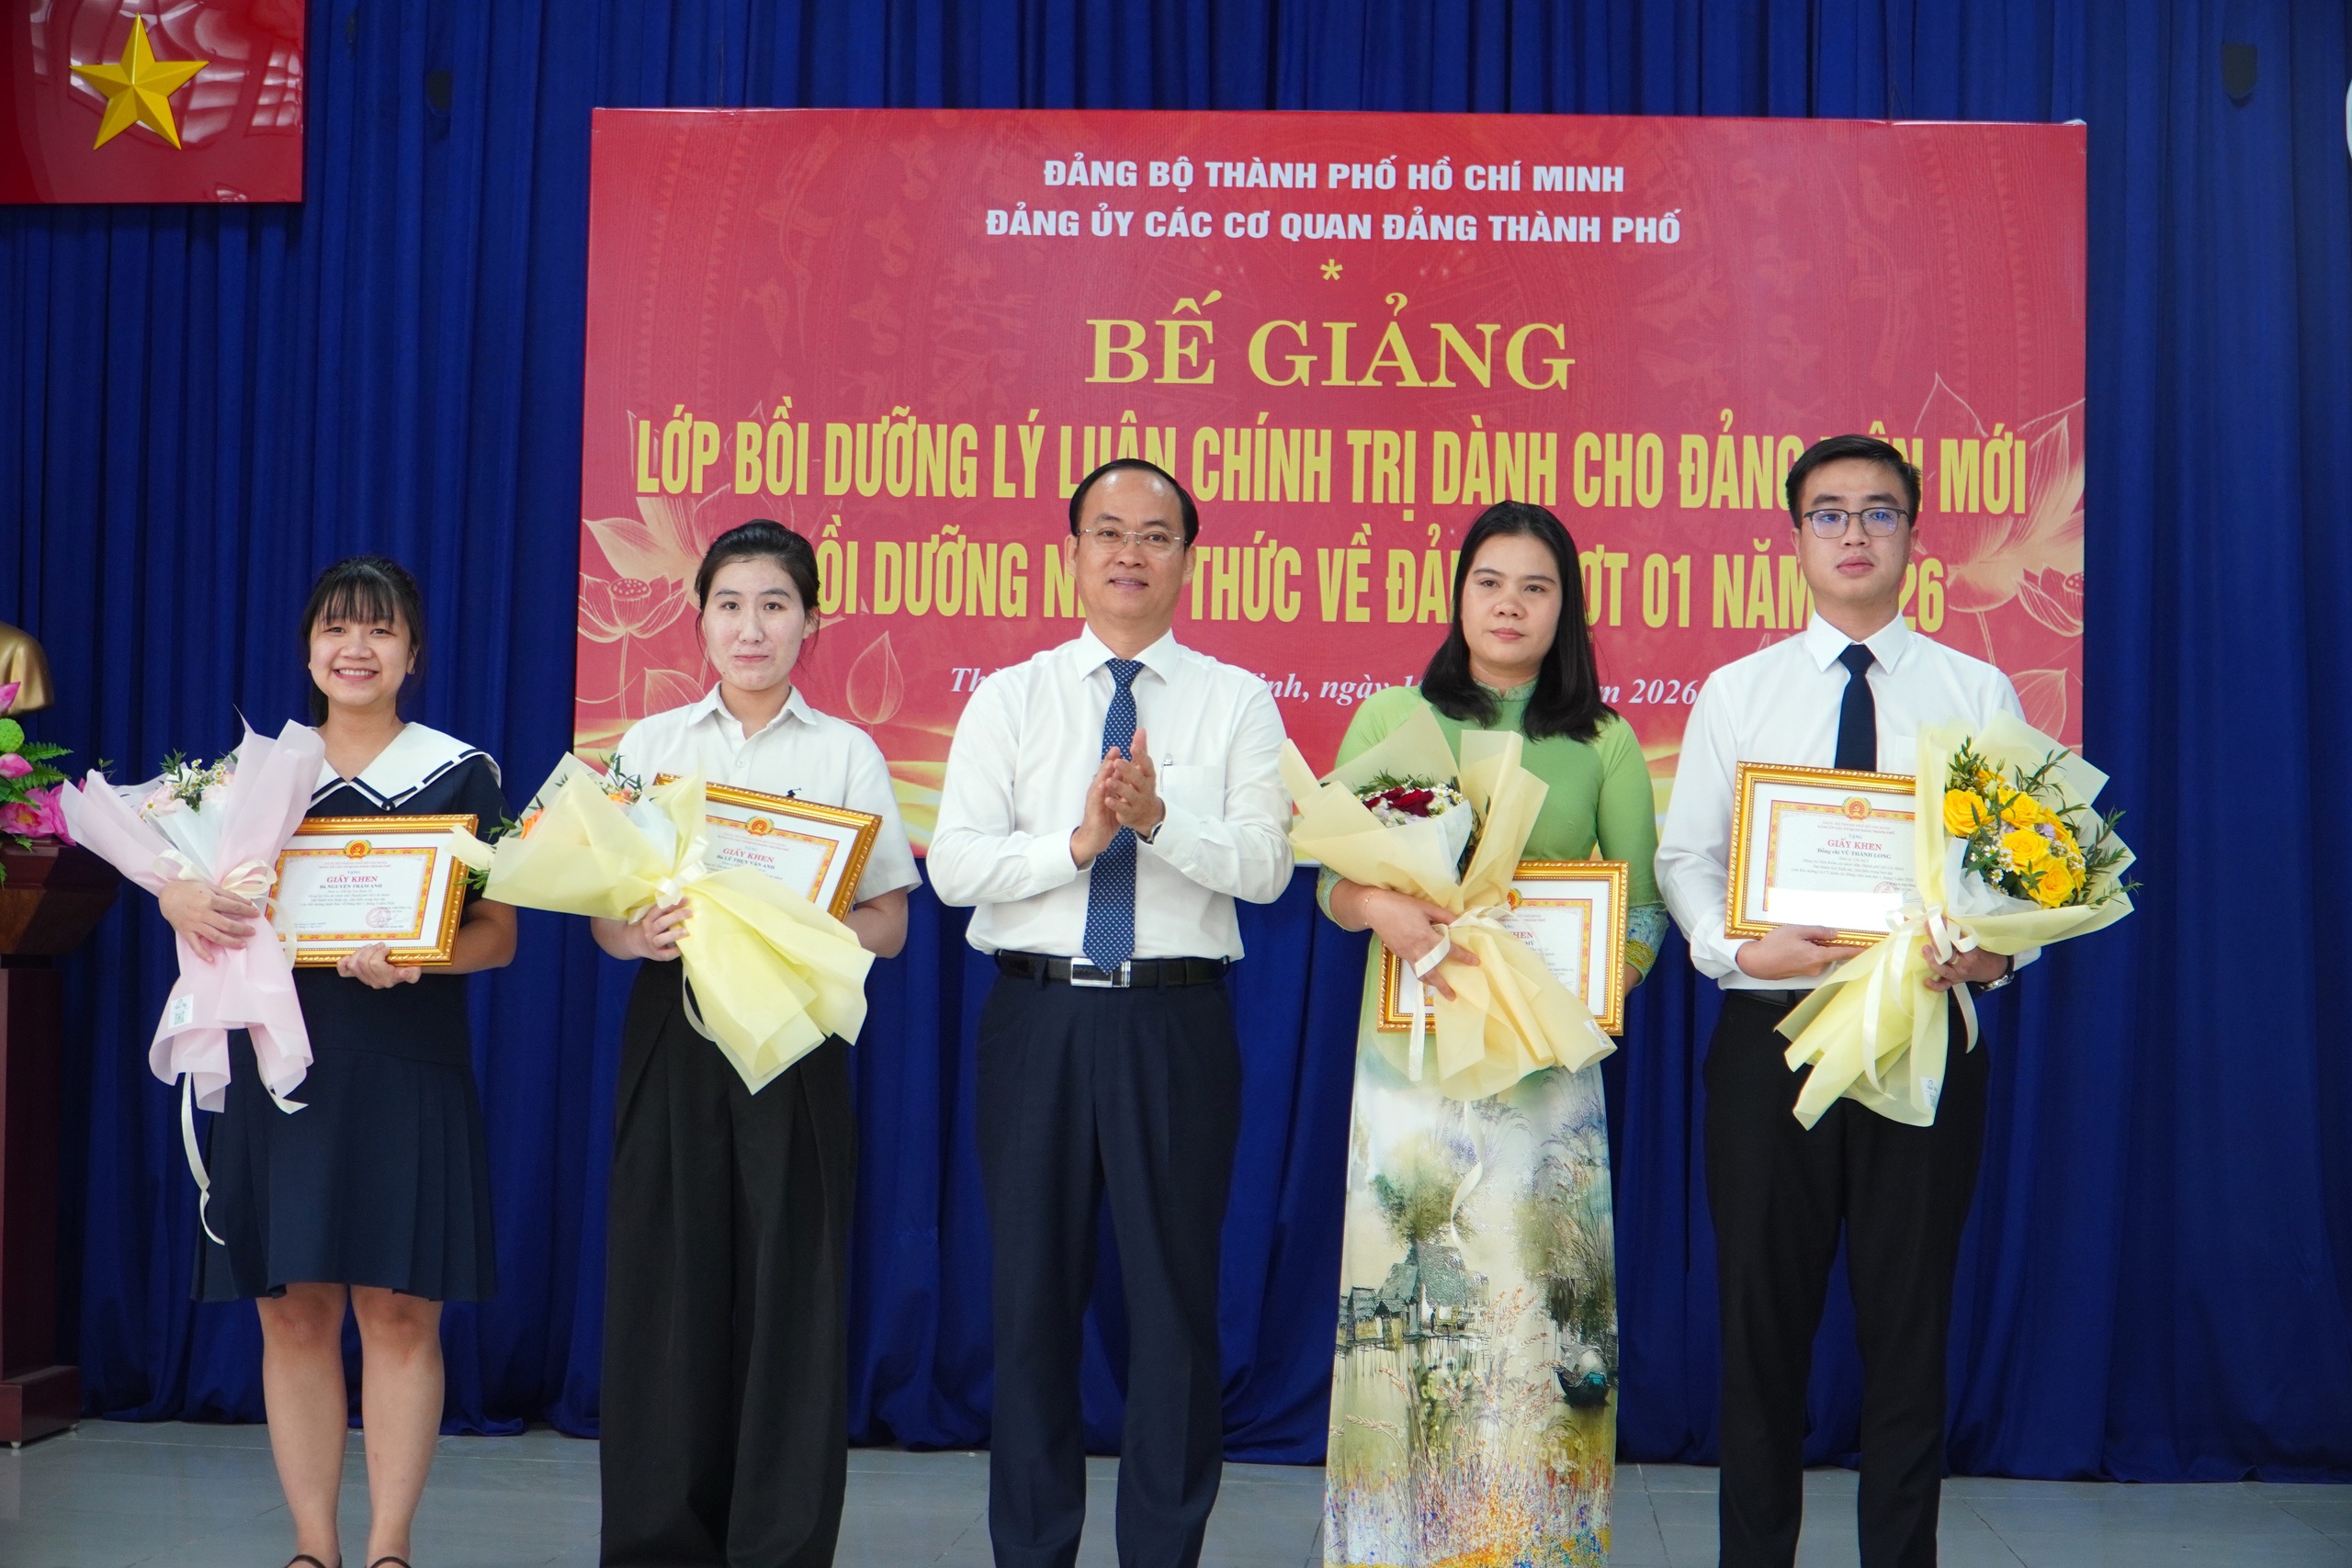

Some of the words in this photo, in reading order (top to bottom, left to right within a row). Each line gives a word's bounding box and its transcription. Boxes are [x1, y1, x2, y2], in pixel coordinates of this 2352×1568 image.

[1044, 152, 1137, 186] ĐẢNG
[1149, 155, 1193, 193] BỘ
[1204, 156, 1317, 189] THÀNH
[1329, 154, 1397, 190] PHỐ
[1408, 156, 1453, 190] HỒ
[1465, 160, 1521, 191] CHÍ
[1533, 166, 1624, 192] MINH
[986, 201, 1080, 236] ĐẢNG
[1091, 202, 1135, 237] ỦY
[1146, 206, 1213, 238] CÁC
[1225, 210, 1271, 239] CƠ
[1281, 213, 1372, 242] QUAN
[1382, 206, 1477, 241] ĐẢNG
[1488, 210, 1600, 243] THÀNH
[1612, 209, 1681, 244] PHỐ
[1085, 289, 1223, 385] BẾ
[1249, 292, 1576, 390] GIẢNG
[638, 404, 720, 494] LỚP
[735, 396, 808, 496] BỒI
[824, 406, 978, 498] DƯỠNG
[993, 408, 1046, 499] LÝ
[1193, 412, 1331, 503] CHÍNH
[1347, 429, 1416, 521] TRỊ
[1432, 415, 1557, 506] DÀNH
[1573, 432, 1664, 508] CHO
[1939, 423, 2027, 514] MỚI
[815, 513, 858, 615] ỒI
[873, 525, 1028, 617] DƯỠNG
[1192, 531, 1302, 622] THỨC
[1307, 522, 1371, 622] VỀ
[1385, 523, 1461, 624] ĐẢ
[1643, 554, 1690, 628] 01
[1713, 538, 1815, 630] NĂM
[1898, 558, 1944, 632] 26
[1628, 678, 1699, 705] 2026
[723, 847, 746, 858] GIẤY
[747, 852, 775, 863] KHEN
[1828, 838, 1852, 849] GIẤY
[1854, 842, 1882, 851] KHEN
[327, 874, 349, 883] GIẤY
